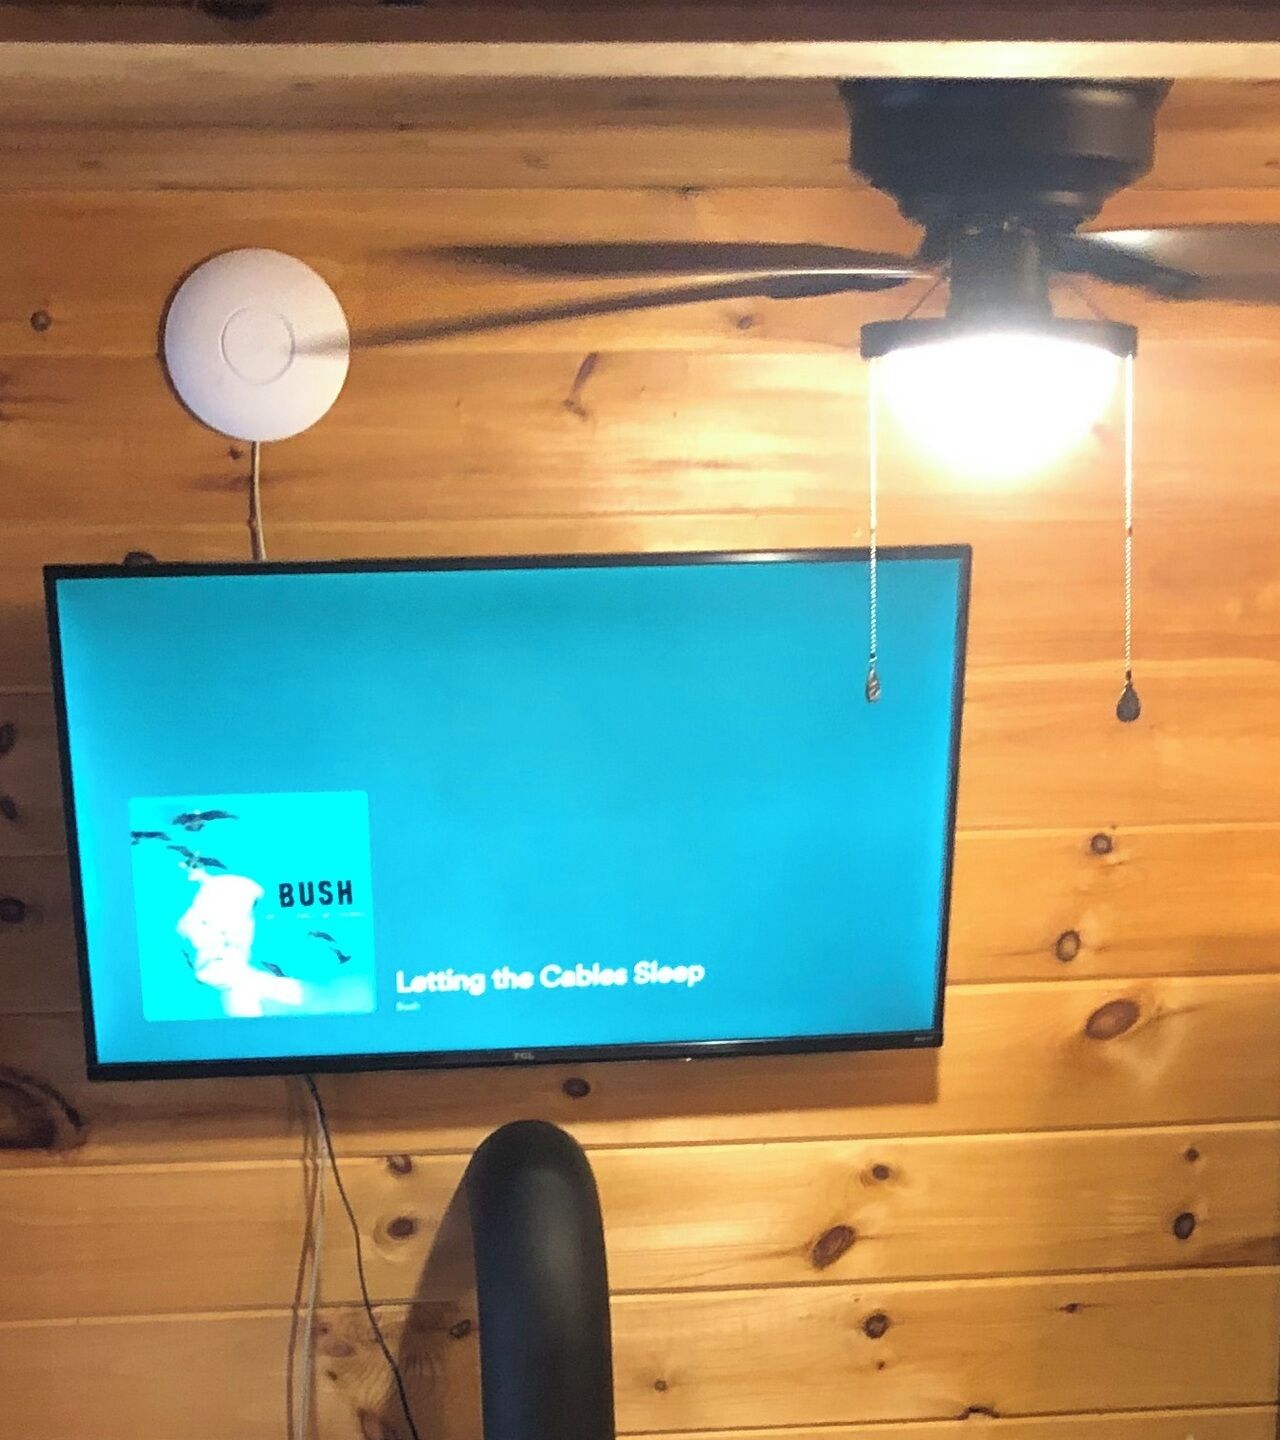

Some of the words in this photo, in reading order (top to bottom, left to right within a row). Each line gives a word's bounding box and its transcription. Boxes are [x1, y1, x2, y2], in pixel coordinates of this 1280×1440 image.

[278, 880, 354, 908] BUSH
[395, 968, 487, 997] Letting
[491, 966, 535, 990] the
[539, 962, 629, 988] Cables
[633, 960, 706, 987] Sleep
